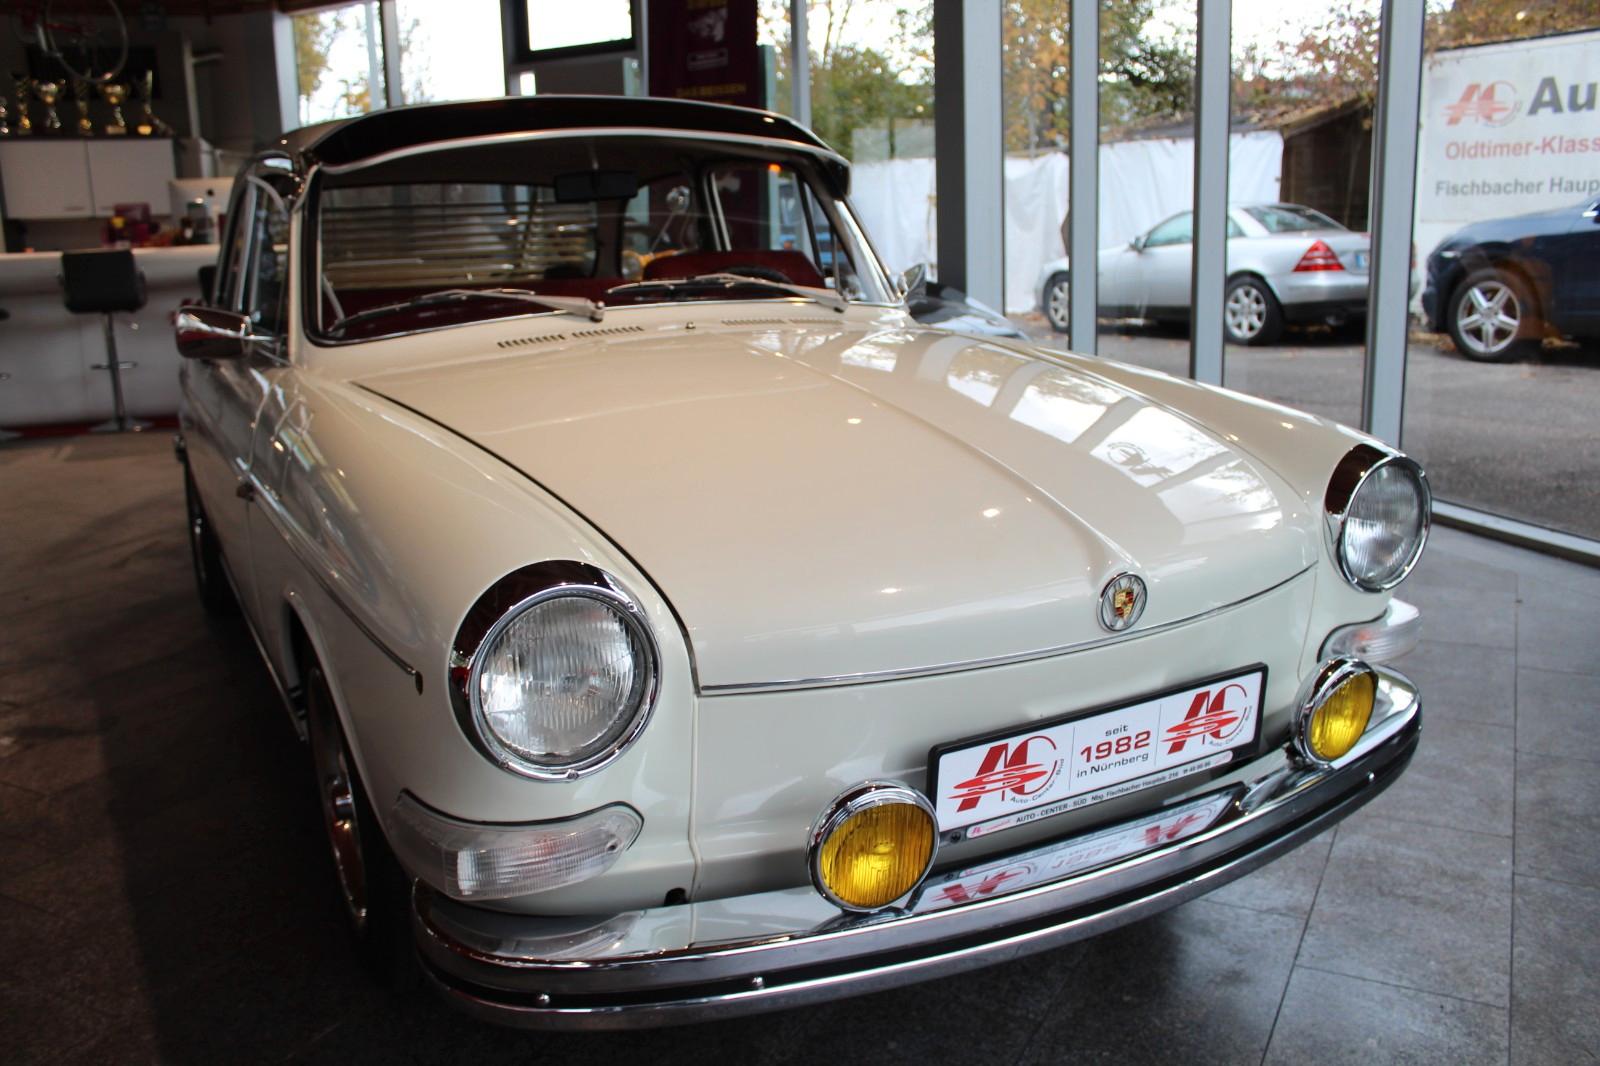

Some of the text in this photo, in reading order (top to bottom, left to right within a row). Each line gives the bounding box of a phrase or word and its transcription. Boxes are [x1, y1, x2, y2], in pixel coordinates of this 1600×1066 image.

[1527, 77, 1599, 116] Au
[1435, 178, 1544, 197] Fischbacher
[1105, 724, 1128, 736] seit
[1080, 730, 1151, 763] 1982
[1077, 752, 1149, 778] in Nürnberg
[1016, 812, 1036, 823] AUTO
[1041, 803, 1068, 816] CENTER
